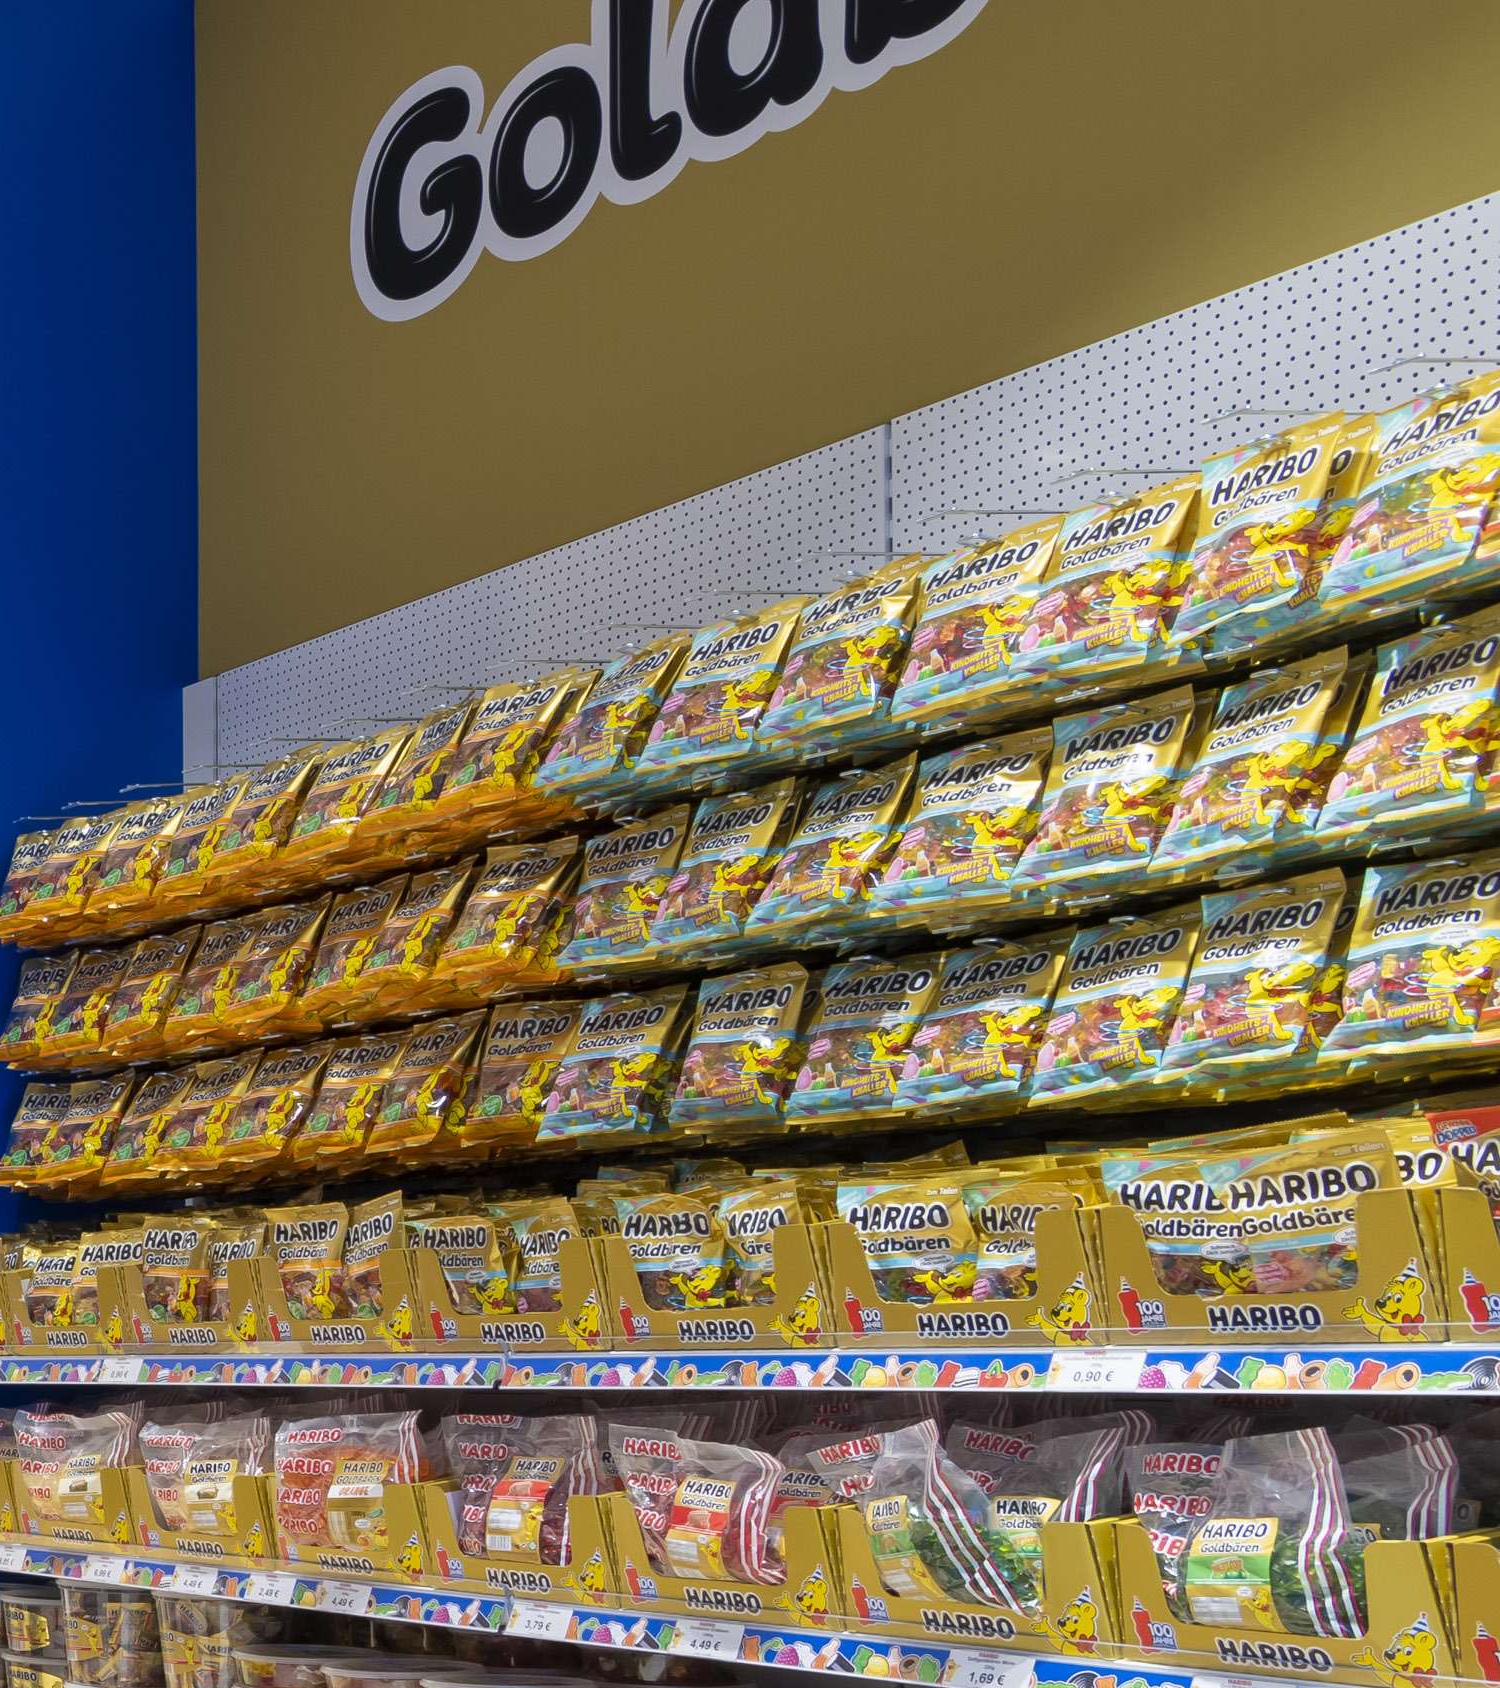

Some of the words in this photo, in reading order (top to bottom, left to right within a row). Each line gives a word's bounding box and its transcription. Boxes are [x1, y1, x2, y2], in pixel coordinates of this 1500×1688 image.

[1212, 447, 1317, 506] HARIBO
[1063, 502, 1175, 553] HARIBO
[1060, 535, 1150, 571] Goldbären
[927, 542, 1038, 592] HARIBO
[691, 623, 779, 661] HARIBO
[1384, 635, 1499, 696] HARIBO
[481, 686, 556, 718] HARIBO
[1214, 681, 1321, 731] HARIBO
[1065, 716, 1174, 763] HARIBO
[925, 752, 1030, 789] HARIBO
[590, 827, 674, 859] HARIBO
[588, 853, 658, 877] Goldbären
[1207, 900, 1321, 941] HARIBO
[1374, 908, 1480, 937] Goldbären
[1072, 928, 1180, 972] HARIBO
[1203, 936, 1300, 962] Goldbären
[826, 970, 931, 998] HARIBO
[945, 952, 1048, 990] HARIBO
[1071, 962, 1159, 991] Goldbären
[703, 985, 792, 1016] HARIBO
[491, 1016, 570, 1039] HARIBO
[582, 1006, 665, 1034] HARIBO
[699, 1014, 778, 1031] Goldbären
[577, 1032, 645, 1050] Goldbären
[1230, 1163, 1377, 1211] HARIBO
[850, 1204, 950, 1231] HARIBO
[275, 1219, 339, 1244] HARIBO
[423, 1225, 487, 1249] HARIBO
[859, 1309, 881, 1323] 100
[918, 1314, 1008, 1337] HARIBO
[1209, 1305, 1321, 1331] HARIBO
[170, 1328, 217, 1345] HARIBO
[1073, 1369, 1102, 1383] 0,90
[1105, 1371, 1114, 1382] €
[286, 1428, 342, 1444] HARIBO
[343, 1462, 383, 1474] HARIBO
[1142, 1453, 1220, 1474] HARIBO
[684, 1481, 731, 1499] HARIBO
[1202, 1523, 1268, 1539] HARIBO
[1201, 1542, 1259, 1553] Goldbären
[332, 1597, 347, 1607] 4,49
[525, 1620, 542, 1630] 3,79
[545, 1622, 551, 1631] €
[923, 1610, 1014, 1639] HARIBO
[690, 1639, 711, 1650] 4,49
[713, 1640, 721, 1651] €
[969, 1671, 994, 1684] 1,69
[996, 1673, 1005, 1684] €
